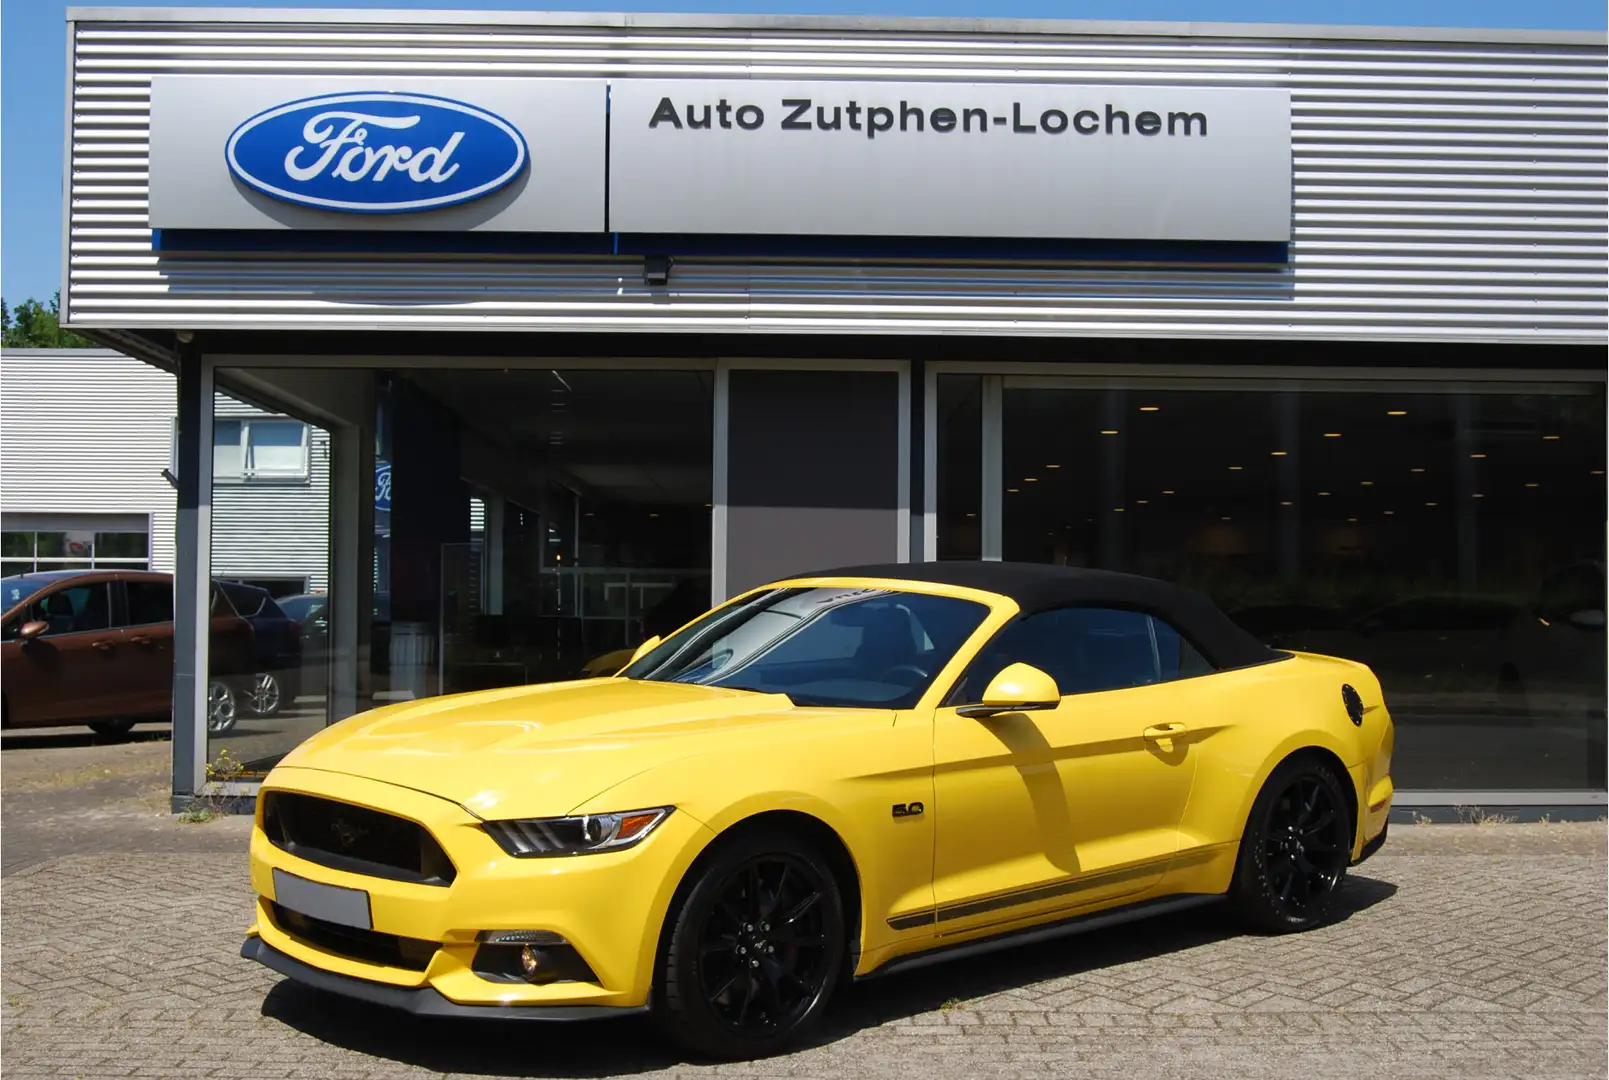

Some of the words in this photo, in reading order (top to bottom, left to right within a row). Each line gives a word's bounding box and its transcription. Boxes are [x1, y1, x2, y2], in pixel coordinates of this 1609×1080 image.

[648, 97, 765, 131] Auto
[781, 98, 1207, 139] Zutphen-Lochem
[284, 111, 466, 183] Ford
[892, 801, 924, 818] 5.0
